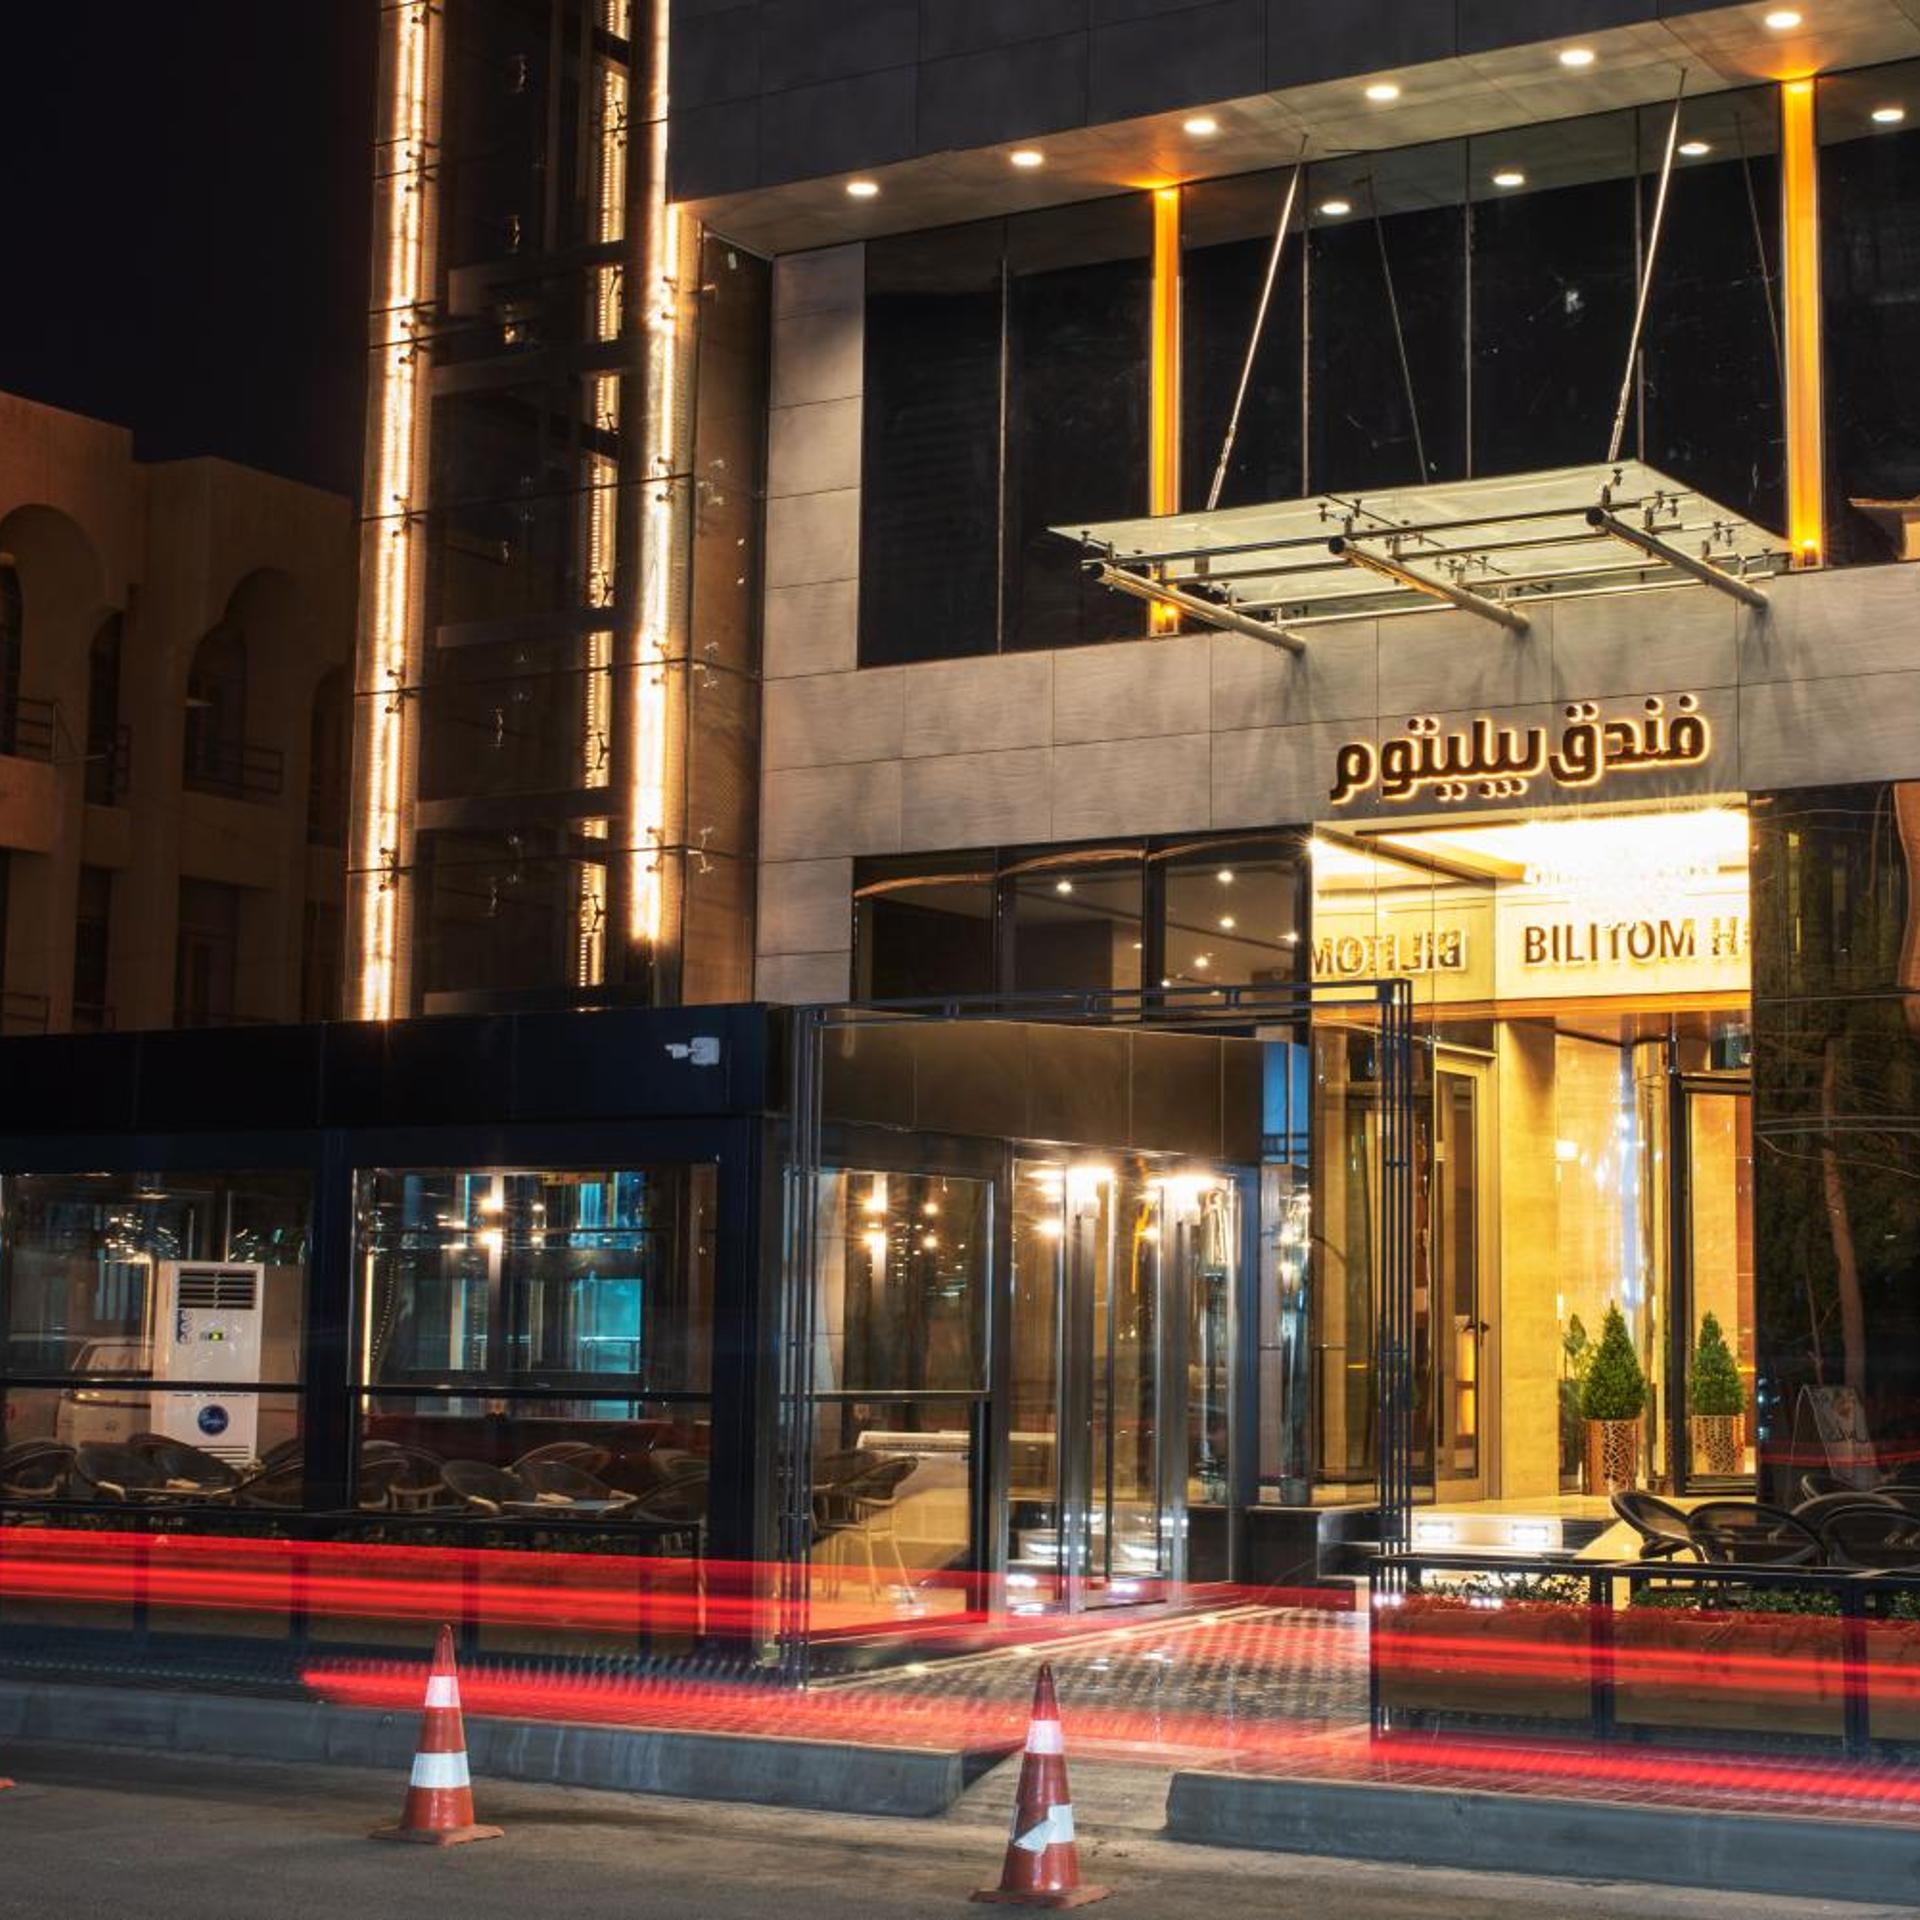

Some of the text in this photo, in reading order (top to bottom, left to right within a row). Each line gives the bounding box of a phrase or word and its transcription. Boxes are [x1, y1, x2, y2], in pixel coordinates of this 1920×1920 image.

[1330, 694, 1711, 804] فندق بيليتوم
[1525, 915, 1750, 965] BILITOM H
